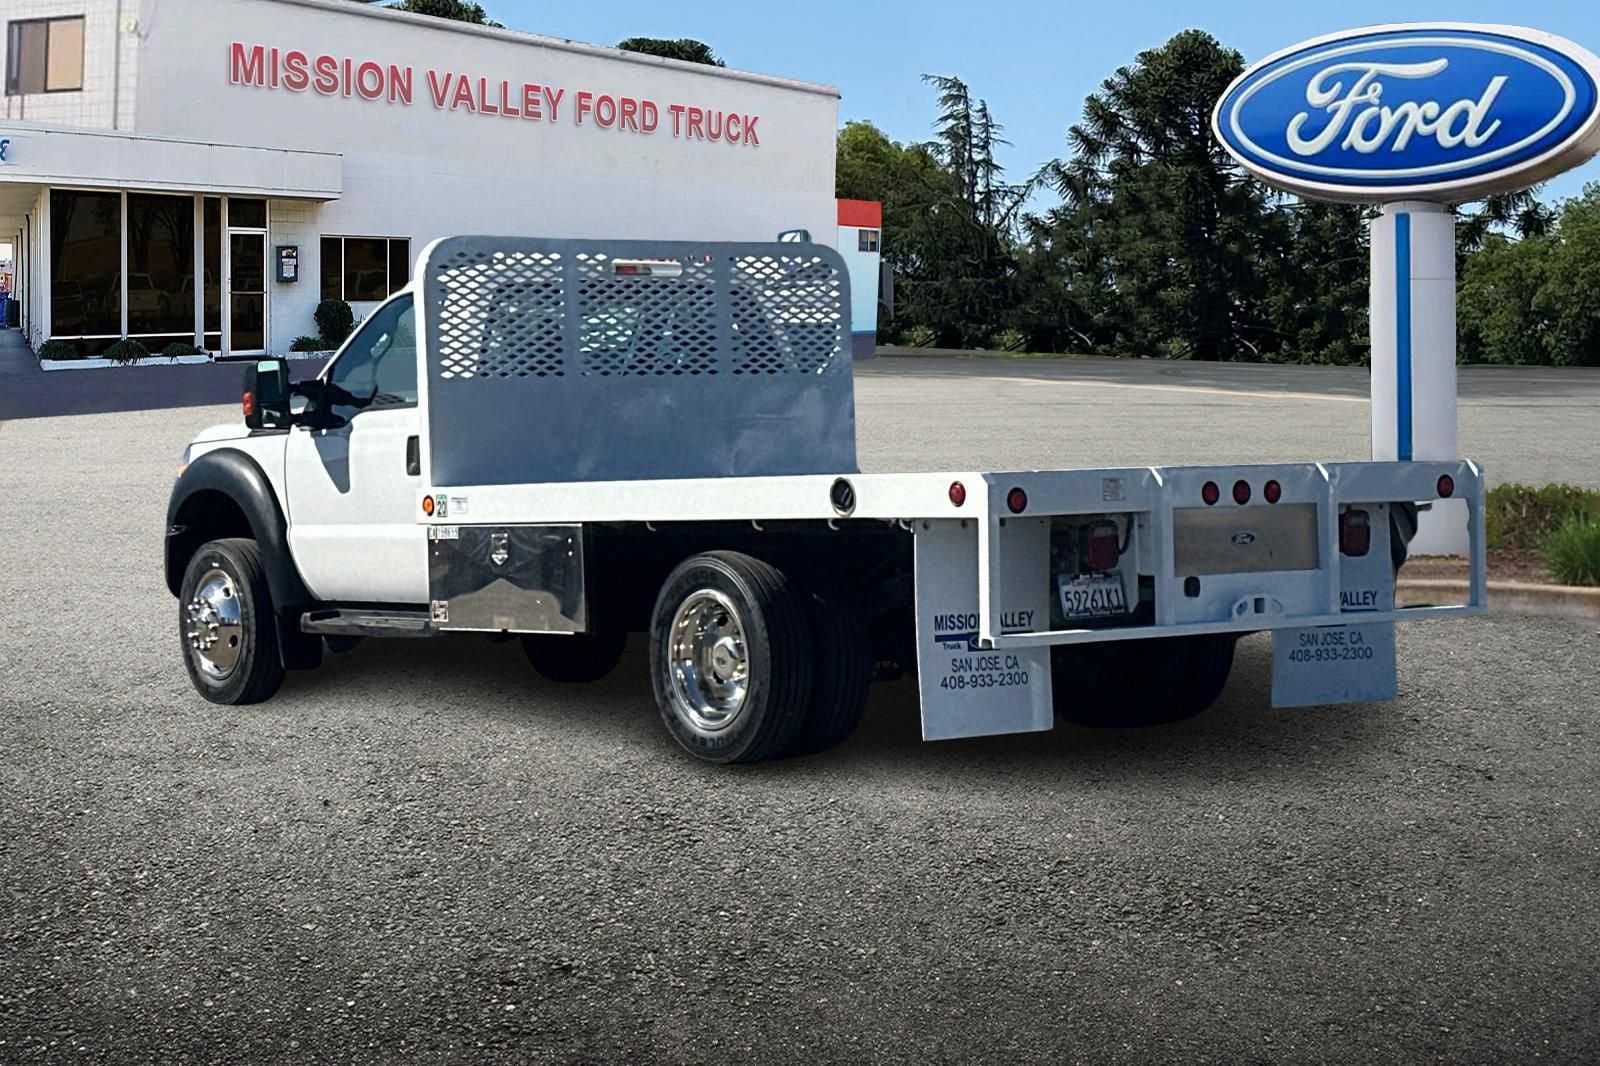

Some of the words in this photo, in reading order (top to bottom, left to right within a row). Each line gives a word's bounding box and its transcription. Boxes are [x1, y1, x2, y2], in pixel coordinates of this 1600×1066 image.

[229, 41, 413, 105] MISSION
[427, 69, 565, 122] VALLEY
[576, 91, 659, 134] FORD
[669, 104, 760, 146] TRUCK
[1286, 57, 1509, 156] Ford
[1064, 587, 1124, 614] 59261K1
[934, 613, 981, 632] MISSIO
[943, 642, 962, 651] Truck
[1299, 632, 1319, 648] SAN
[1320, 631, 1348, 648] JOSE,
[1349, 630, 1364, 645] CA
[1288, 646, 1373, 663] 408-933-2300
[951, 657, 973, 674] SAN
[974, 656, 1003, 672] JOSE,
[1005, 655, 1020, 670] CA
[940, 671, 1029, 691] 408-933-2300
